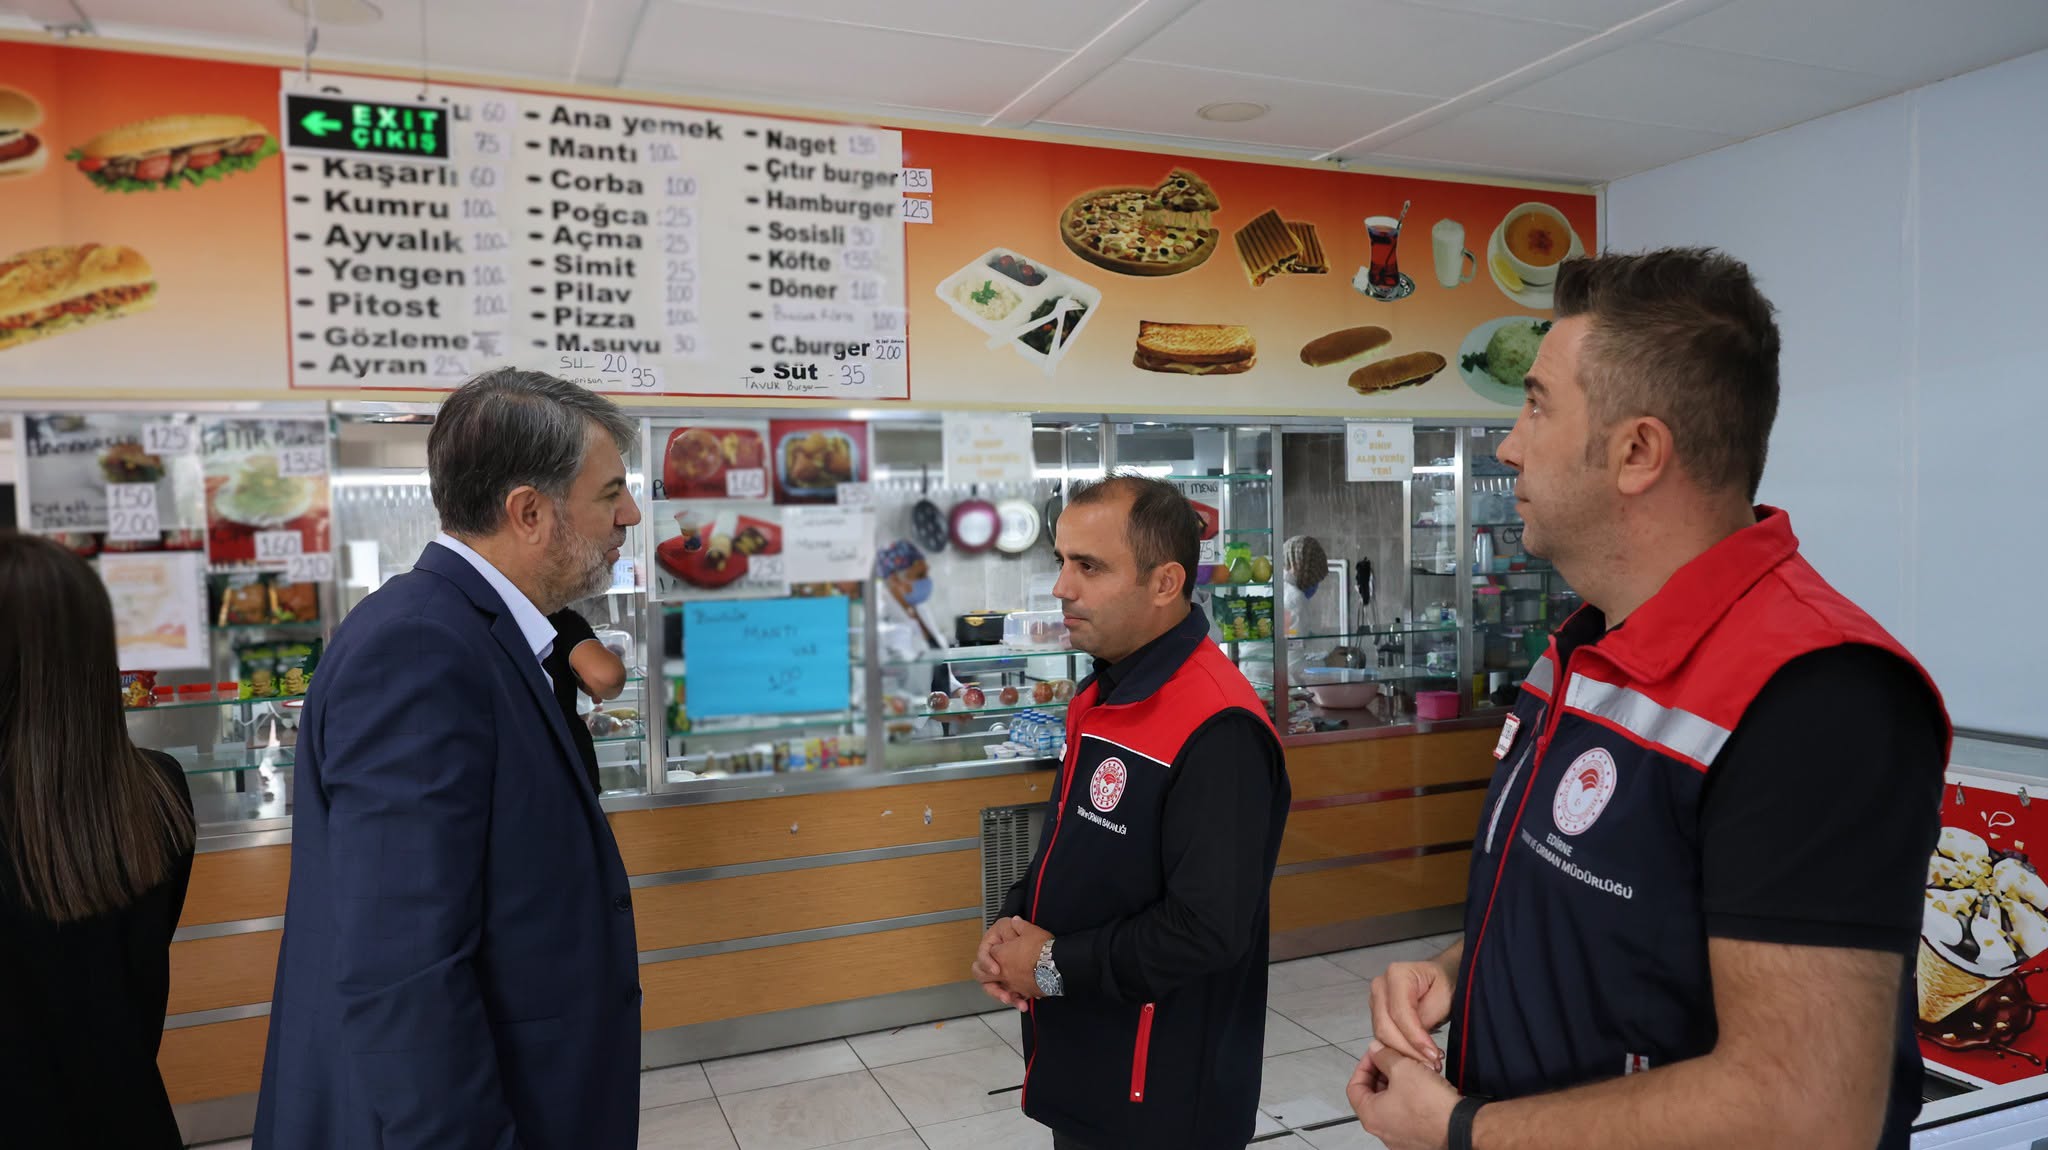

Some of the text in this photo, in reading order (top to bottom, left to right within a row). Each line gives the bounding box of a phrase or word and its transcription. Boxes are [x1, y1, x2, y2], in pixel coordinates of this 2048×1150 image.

[351, 104, 438, 131] EXIT
[550, 105, 723, 141] Ana yemek
[351, 128, 437, 154] ÇIKIŞ
[549, 137, 638, 163] Mantı
[766, 130, 836, 156] Naget
[323, 157, 458, 188] Kaşarlı
[469, 166, 495, 187] 60
[766, 158, 898, 189] Çıtır burger
[902, 170, 928, 188] 135
[667, 176, 696, 195] 100
[324, 190, 449, 219] Kumru
[766, 190, 894, 220] Hamburger
[902, 200, 930, 218] 125
[324, 224, 464, 253] Ayvalık
[553, 226, 642, 252] Açma
[767, 222, 844, 246] Sosisli
[326, 257, 466, 288] Yengen
[554, 254, 636, 278] Simit
[667, 261, 696, 282] 25
[768, 250, 830, 272] Köfte
[555, 281, 632, 304] Pilav
[769, 279, 837, 300] Döner
[328, 291, 440, 318] Pitost
[554, 306, 635, 330] Pizza
[324, 326, 469, 350] Gözleme
[771, 336, 871, 361] C.burger
[601, 353, 627, 373] 20
[875, 345, 901, 360] 200
[328, 353, 427, 377] Ayran
[773, 362, 818, 381] Süt
[840, 364, 866, 386] 35
[631, 367, 656, 388] 35
[740, 376, 780, 391] TAVUK
[149, 427, 189, 450] 125
[112, 488, 152, 509] 150
[112, 512, 157, 536] 200
[1546, 832, 1573, 857] EDİRNE
[1535, 843, 1562, 868] ORMAN
[1560, 860, 1633, 899] MÜDÜRLÜĞÜ
